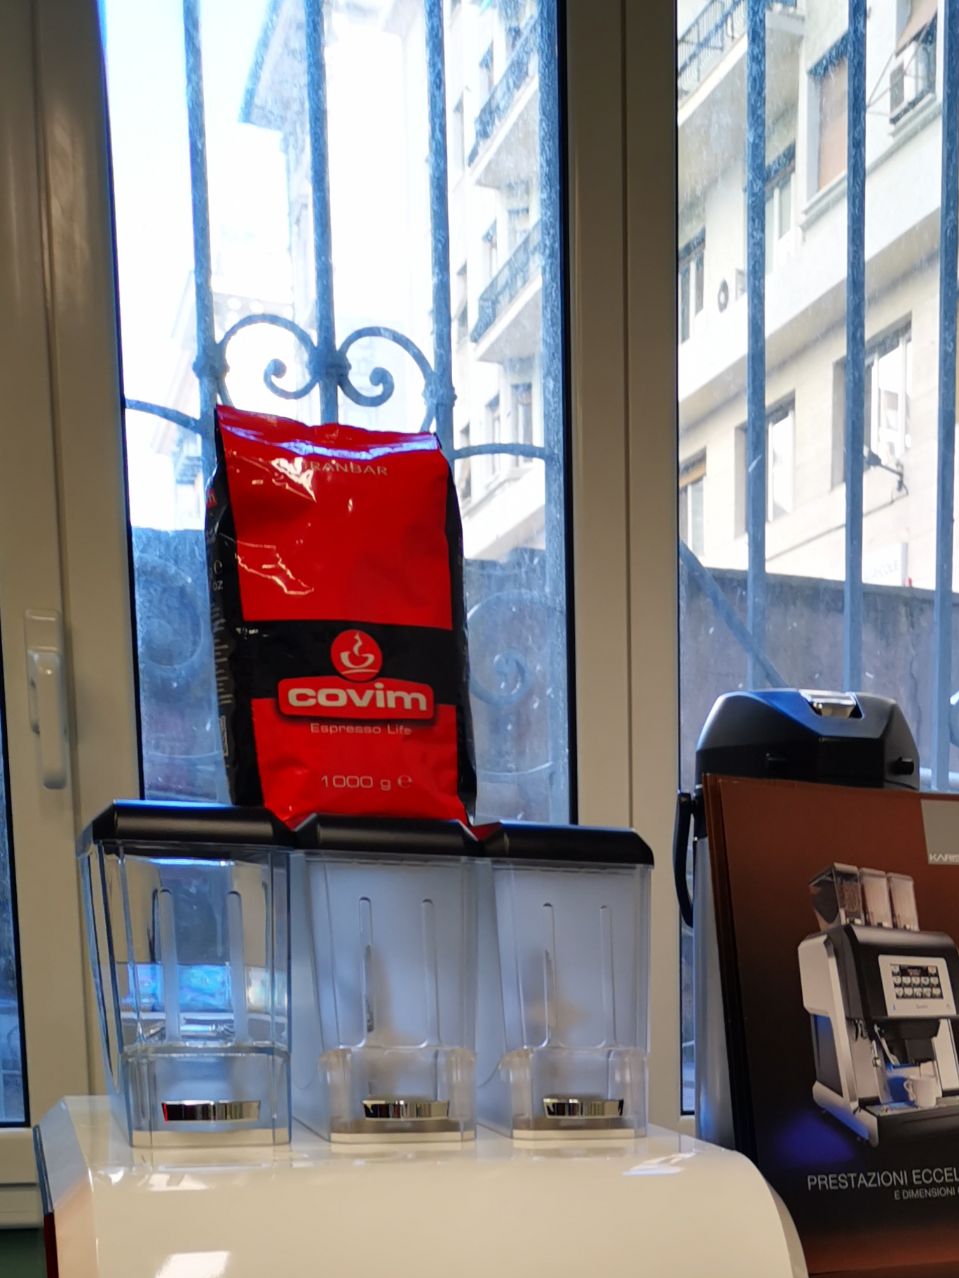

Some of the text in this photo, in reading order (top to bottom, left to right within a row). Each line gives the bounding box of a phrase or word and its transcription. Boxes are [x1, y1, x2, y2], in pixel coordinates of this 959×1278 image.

[287, 682, 428, 712] covim
[310, 722, 413, 736] Espresso Life
[321, 774, 374, 789] 1000
[380, 778, 392, 792] g
[807, 1170, 908, 1191] PRESTAZIONI
[894, 1191, 901, 1200] E
[902, 1186, 956, 1200] DIMENSIONI
